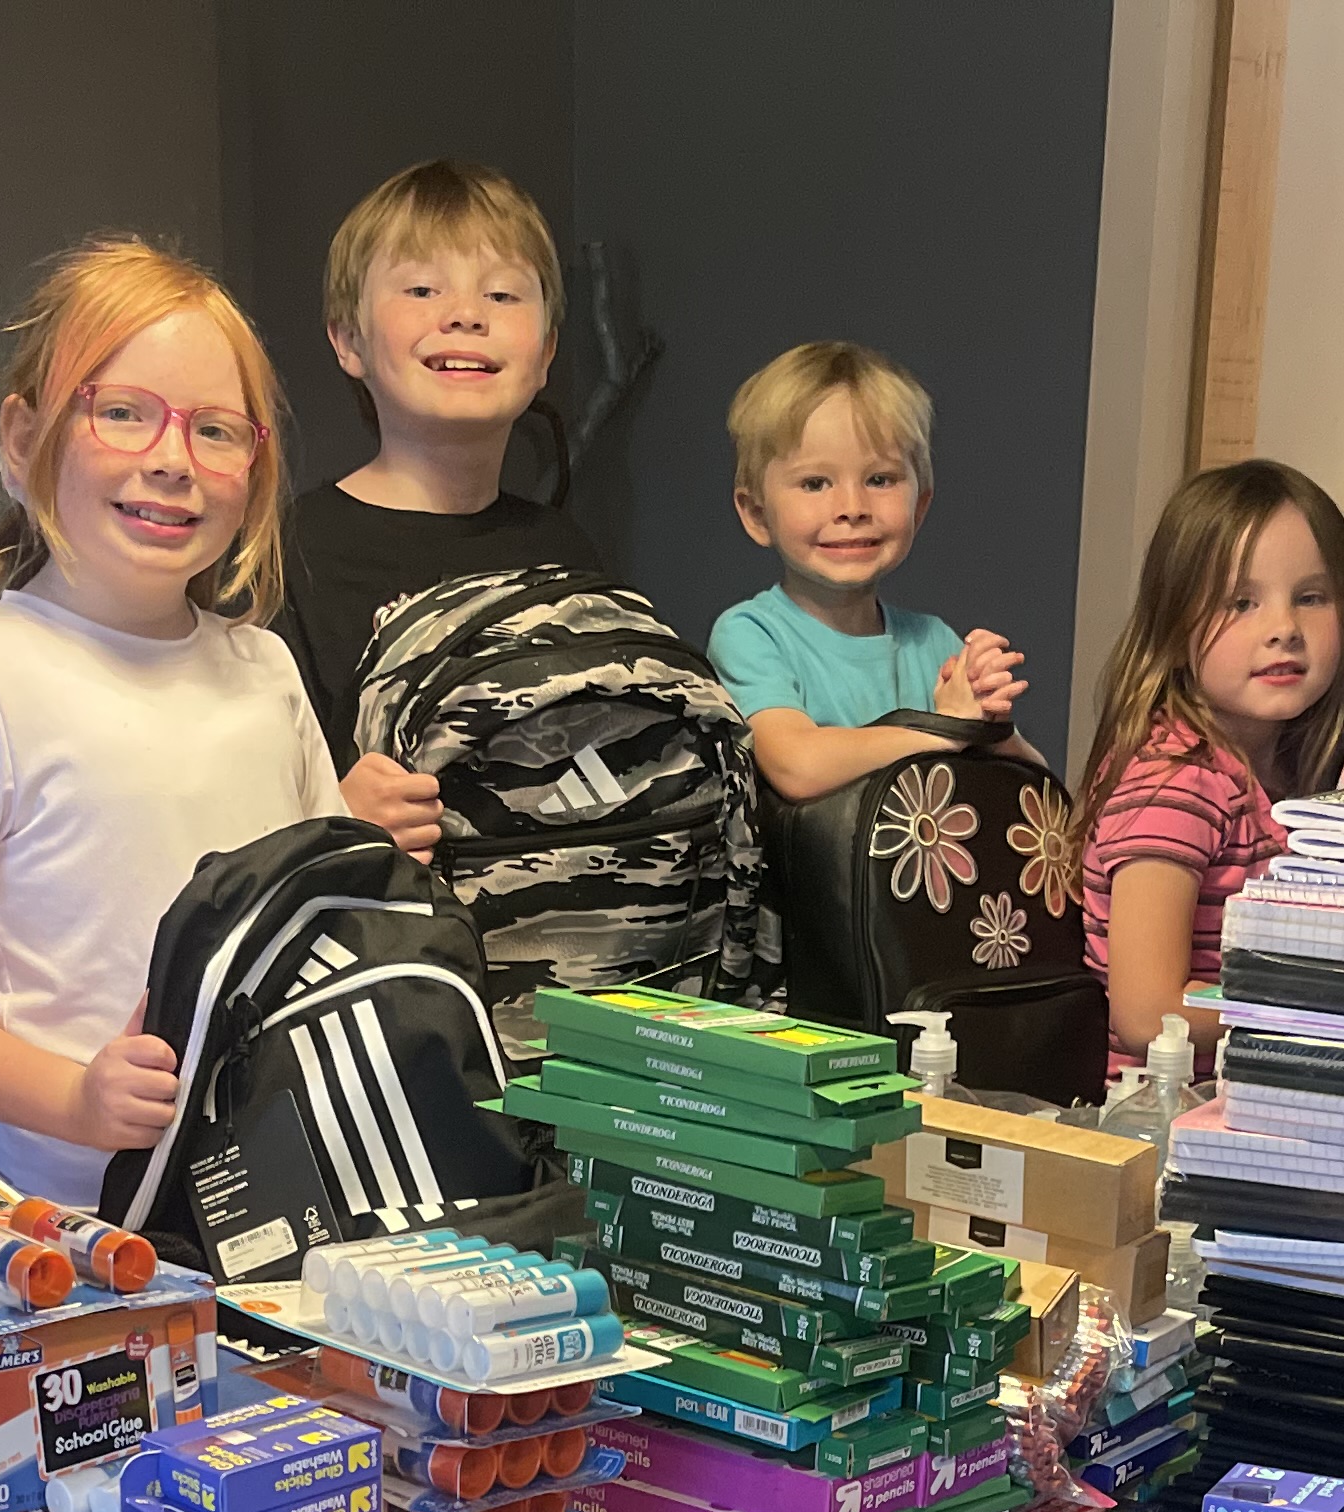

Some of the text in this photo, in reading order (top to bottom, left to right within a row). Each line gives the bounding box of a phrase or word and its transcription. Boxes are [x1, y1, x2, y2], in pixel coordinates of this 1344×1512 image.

[635, 1025, 694, 1049] TICONDEROGA
[645, 1056, 703, 1081] TICONDEROGA
[659, 1094, 727, 1117] TICONDEROGA
[613, 1118, 677, 1141] TICONDEROGA
[656, 1155, 714, 1181] TICONDEROGA
[632, 1177, 715, 1211] TICONDEROGA
[661, 1244, 743, 1279] TICONDEROGA
[734, 1232, 822, 1266] TICONDEROGA
[634, 1296, 707, 1331] TICONDEROGA
[684, 1288, 763, 1324] TICONDEROGA
[43, 1369, 138, 1414] 30 Washable
[55, 1416, 144, 1455] School Glue
[282, 1449, 344, 1475] Washable
[863, 1461, 915, 1494] sharpened
[969, 1447, 1007, 1477] pencils
[874, 1478, 916, 1507] pencils
